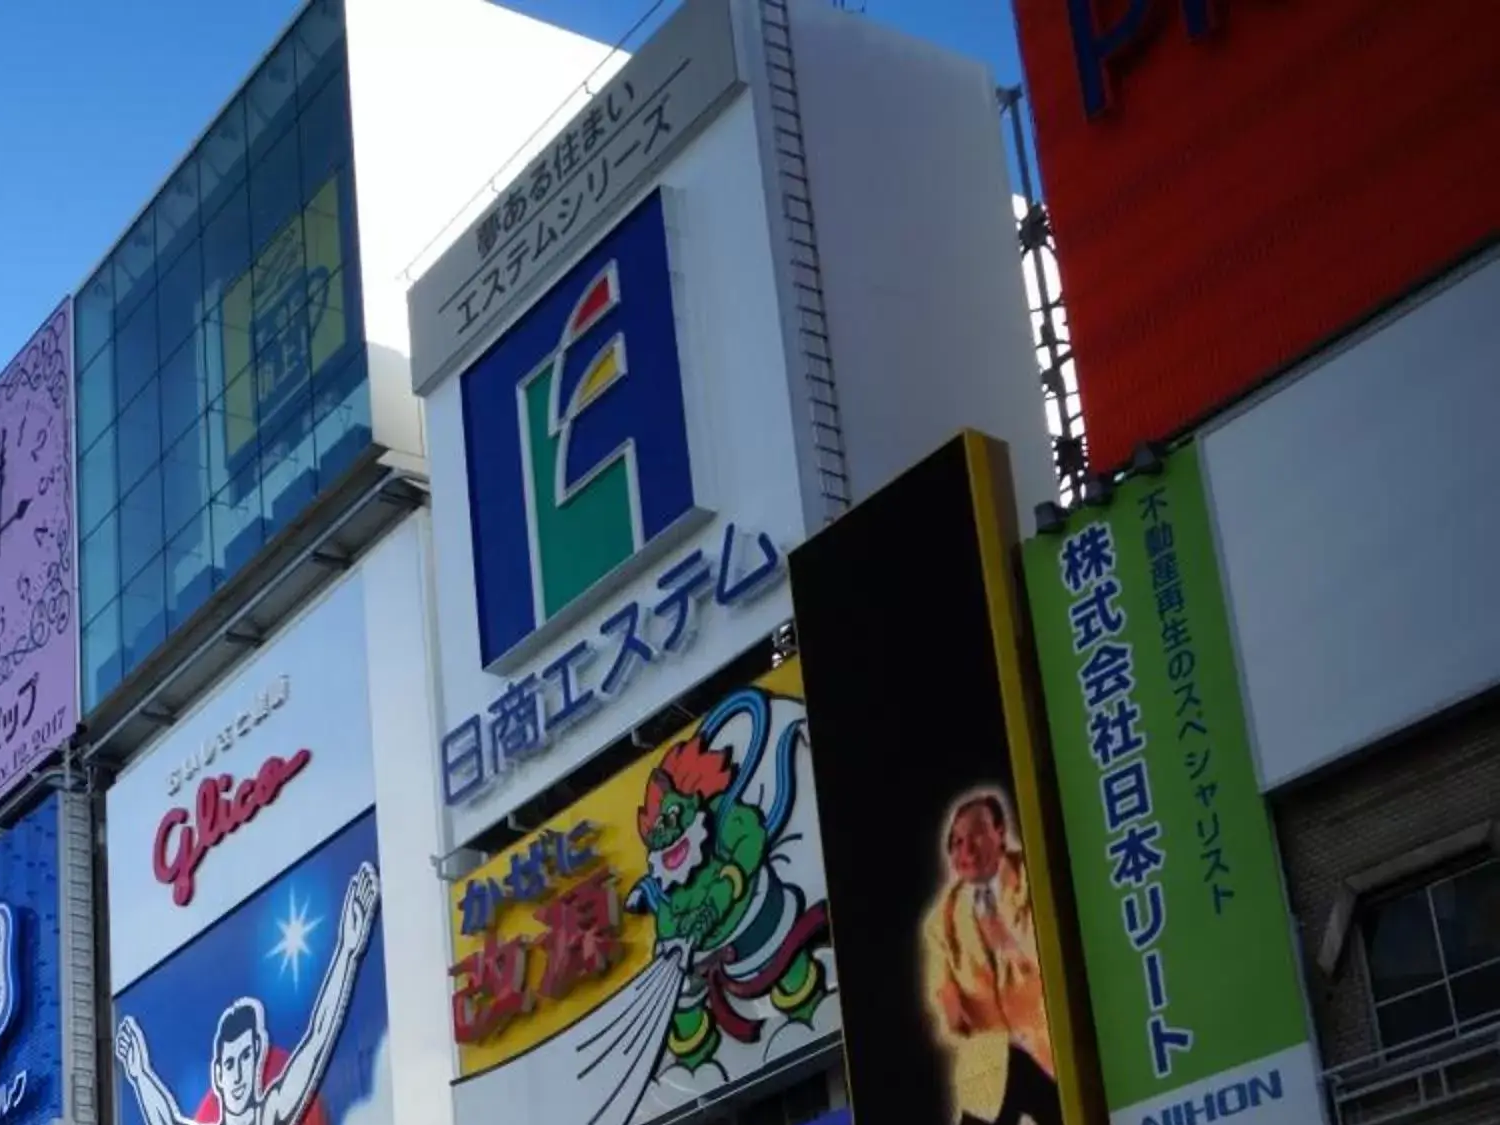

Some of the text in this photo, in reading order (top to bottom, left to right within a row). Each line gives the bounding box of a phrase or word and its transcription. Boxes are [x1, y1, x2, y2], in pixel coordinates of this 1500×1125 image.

[456, 94, 672, 335] エステムシリーズ
[475, 80, 636, 260] 夢ある住まい
[442, 523, 781, 806] 日商エステム
[1137, 486, 1235, 915] 不動産再生のスペシャリスト
[152, 747, 313, 908] Glico
[1060, 520, 1194, 1078] 株式会社日本リート
